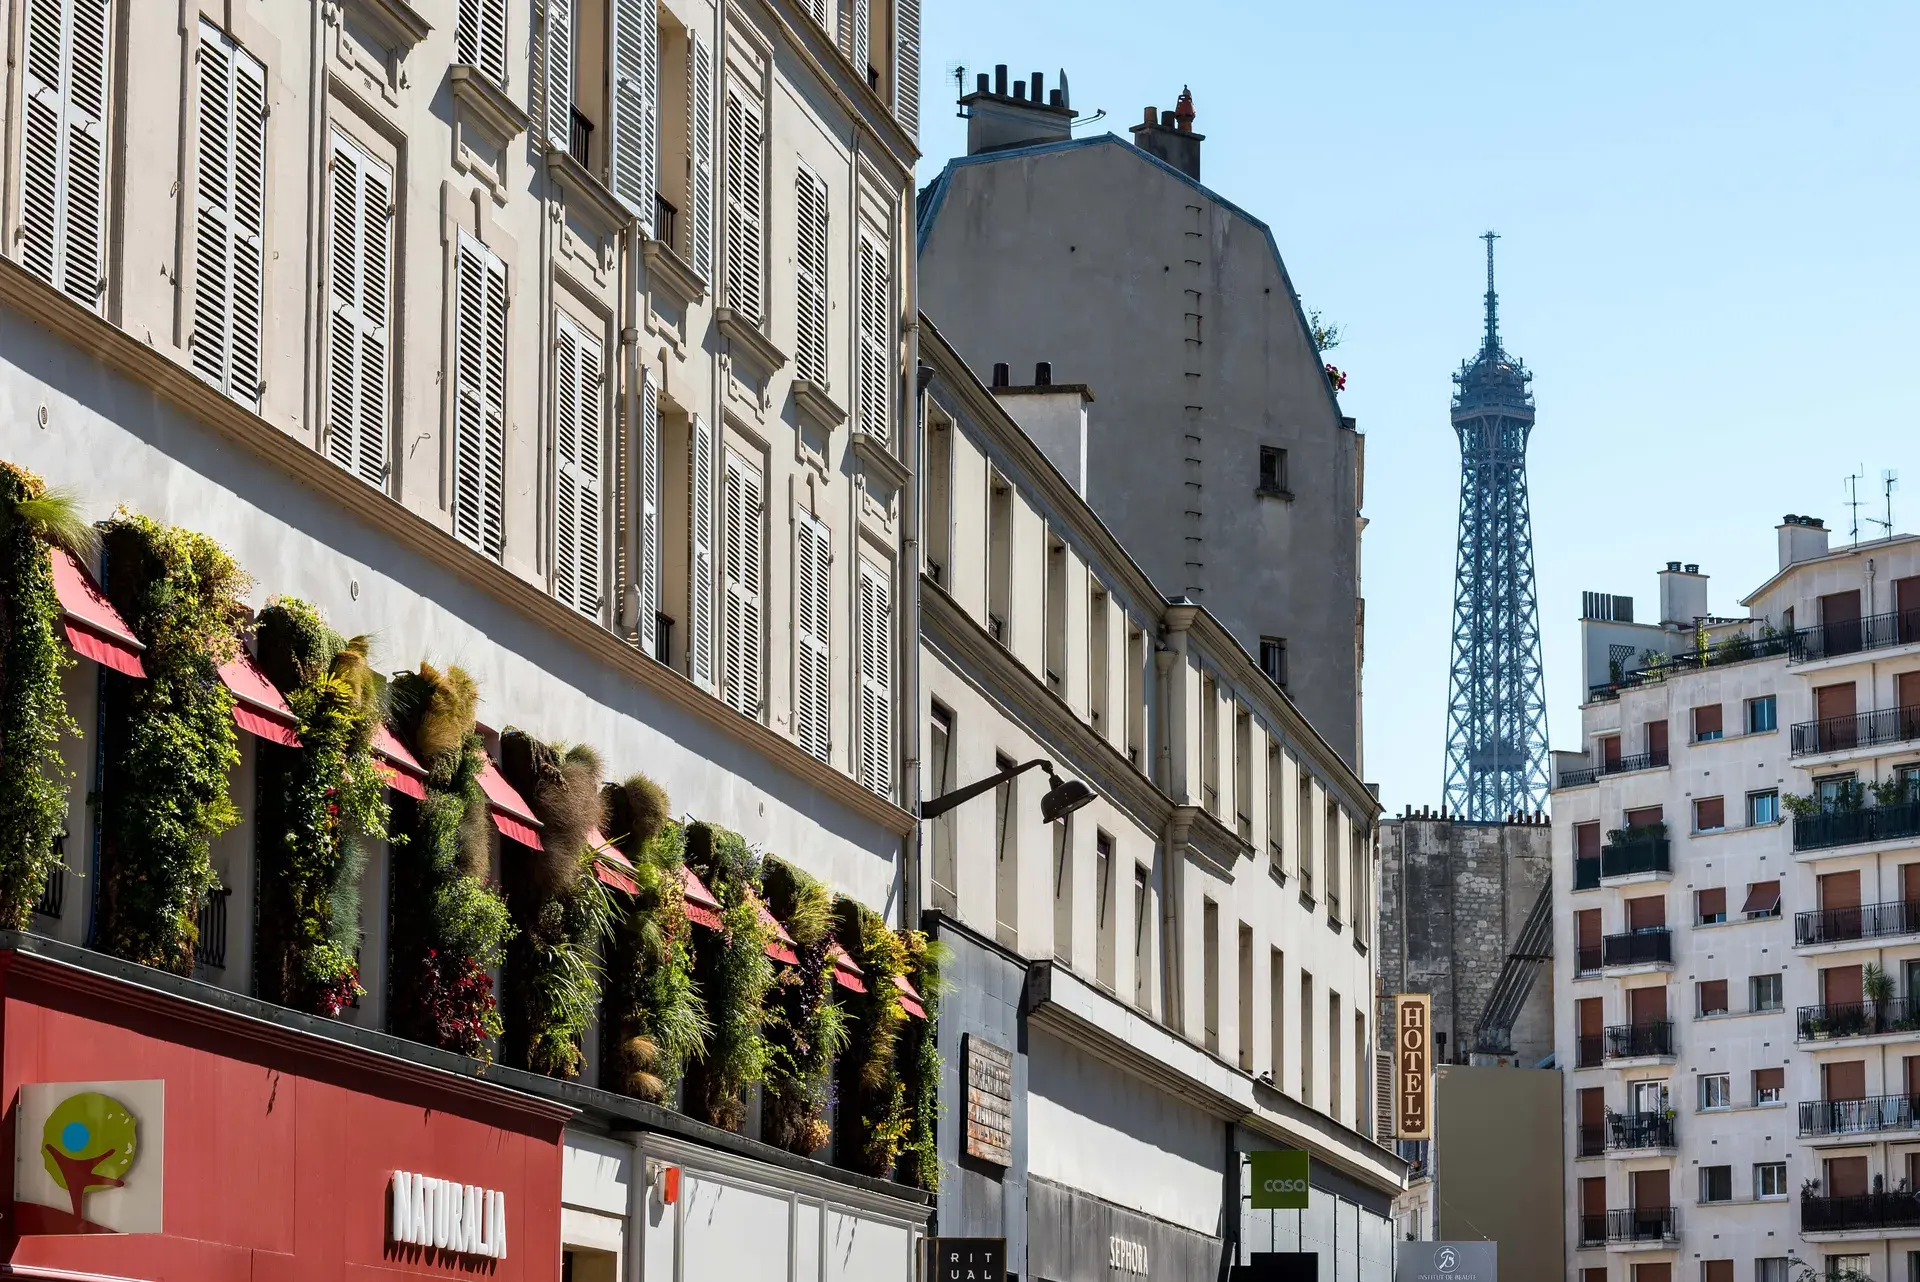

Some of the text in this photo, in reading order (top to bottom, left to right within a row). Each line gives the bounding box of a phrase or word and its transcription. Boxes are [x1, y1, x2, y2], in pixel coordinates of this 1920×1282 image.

[1403, 1007, 1423, 1115] HOTEL
[393, 1170, 507, 1260] NATURALIA
[1264, 1179, 1306, 1192] casa
[1109, 1236, 1149, 1275] SEPHORA
